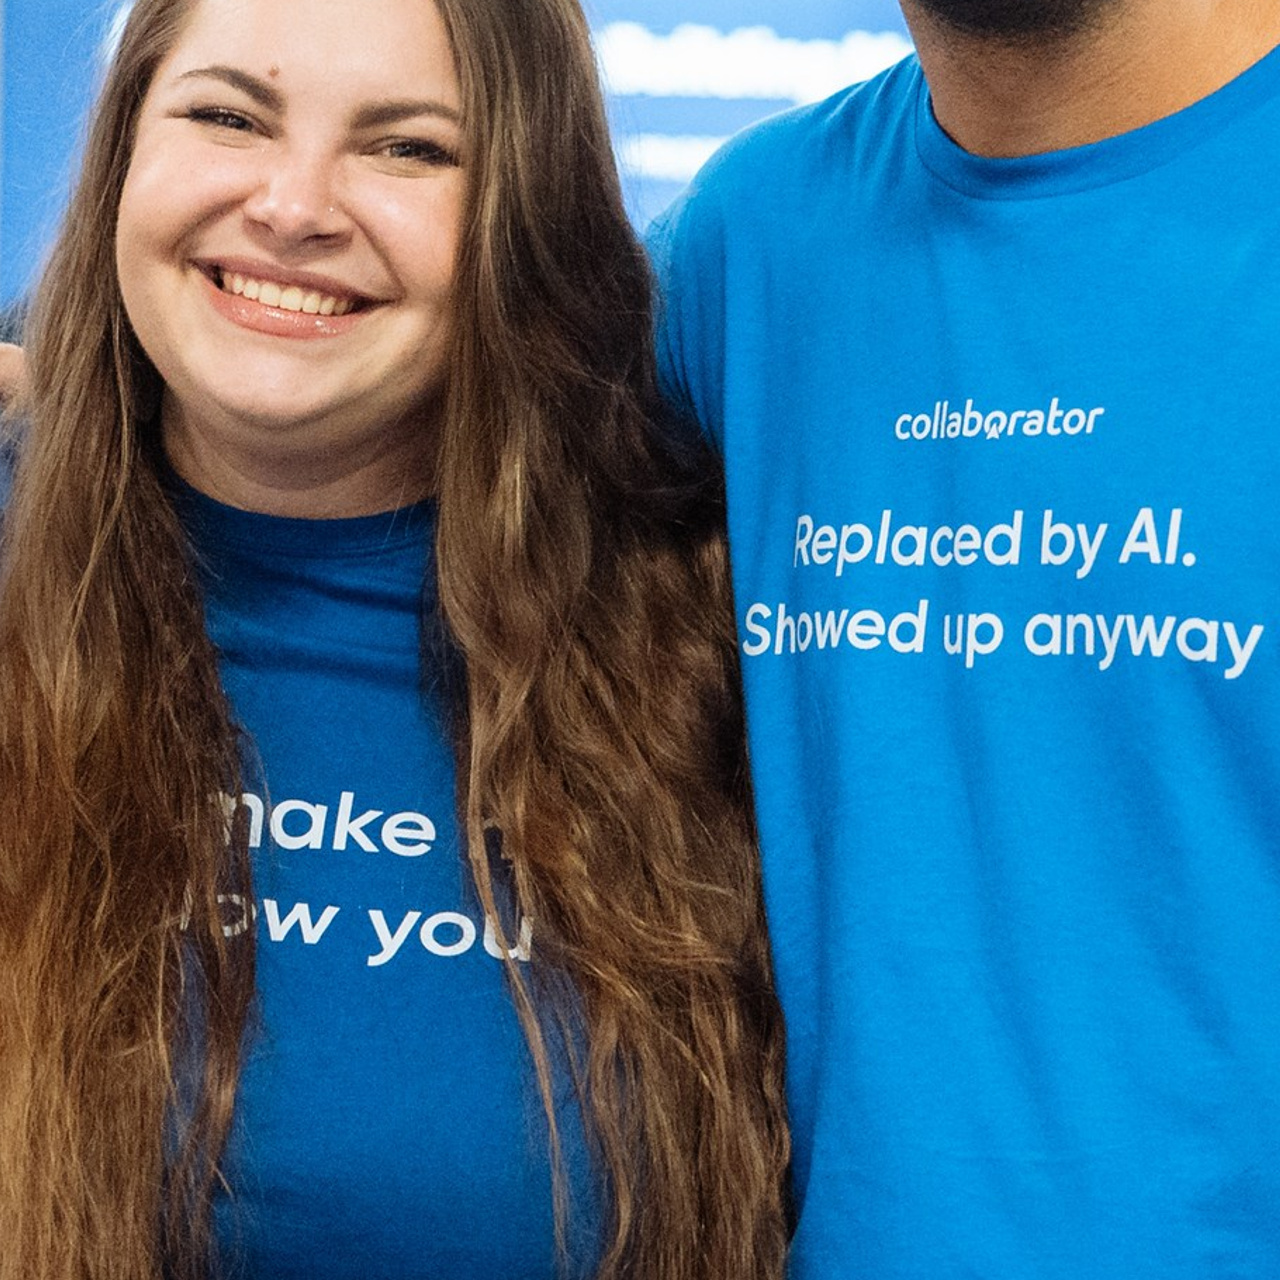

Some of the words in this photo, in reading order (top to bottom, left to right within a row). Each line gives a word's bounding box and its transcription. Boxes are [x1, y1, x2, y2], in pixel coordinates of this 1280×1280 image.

[894, 397, 1105, 440] collaborator
[793, 509, 1024, 577] Replaced
[1039, 509, 1108, 579] by
[1117, 507, 1197, 567] AI.
[742, 599, 929, 656] Showed
[943, 613, 1004, 669] up
[1023, 613, 1265, 680] anyway
[366, 909, 535, 967] you
